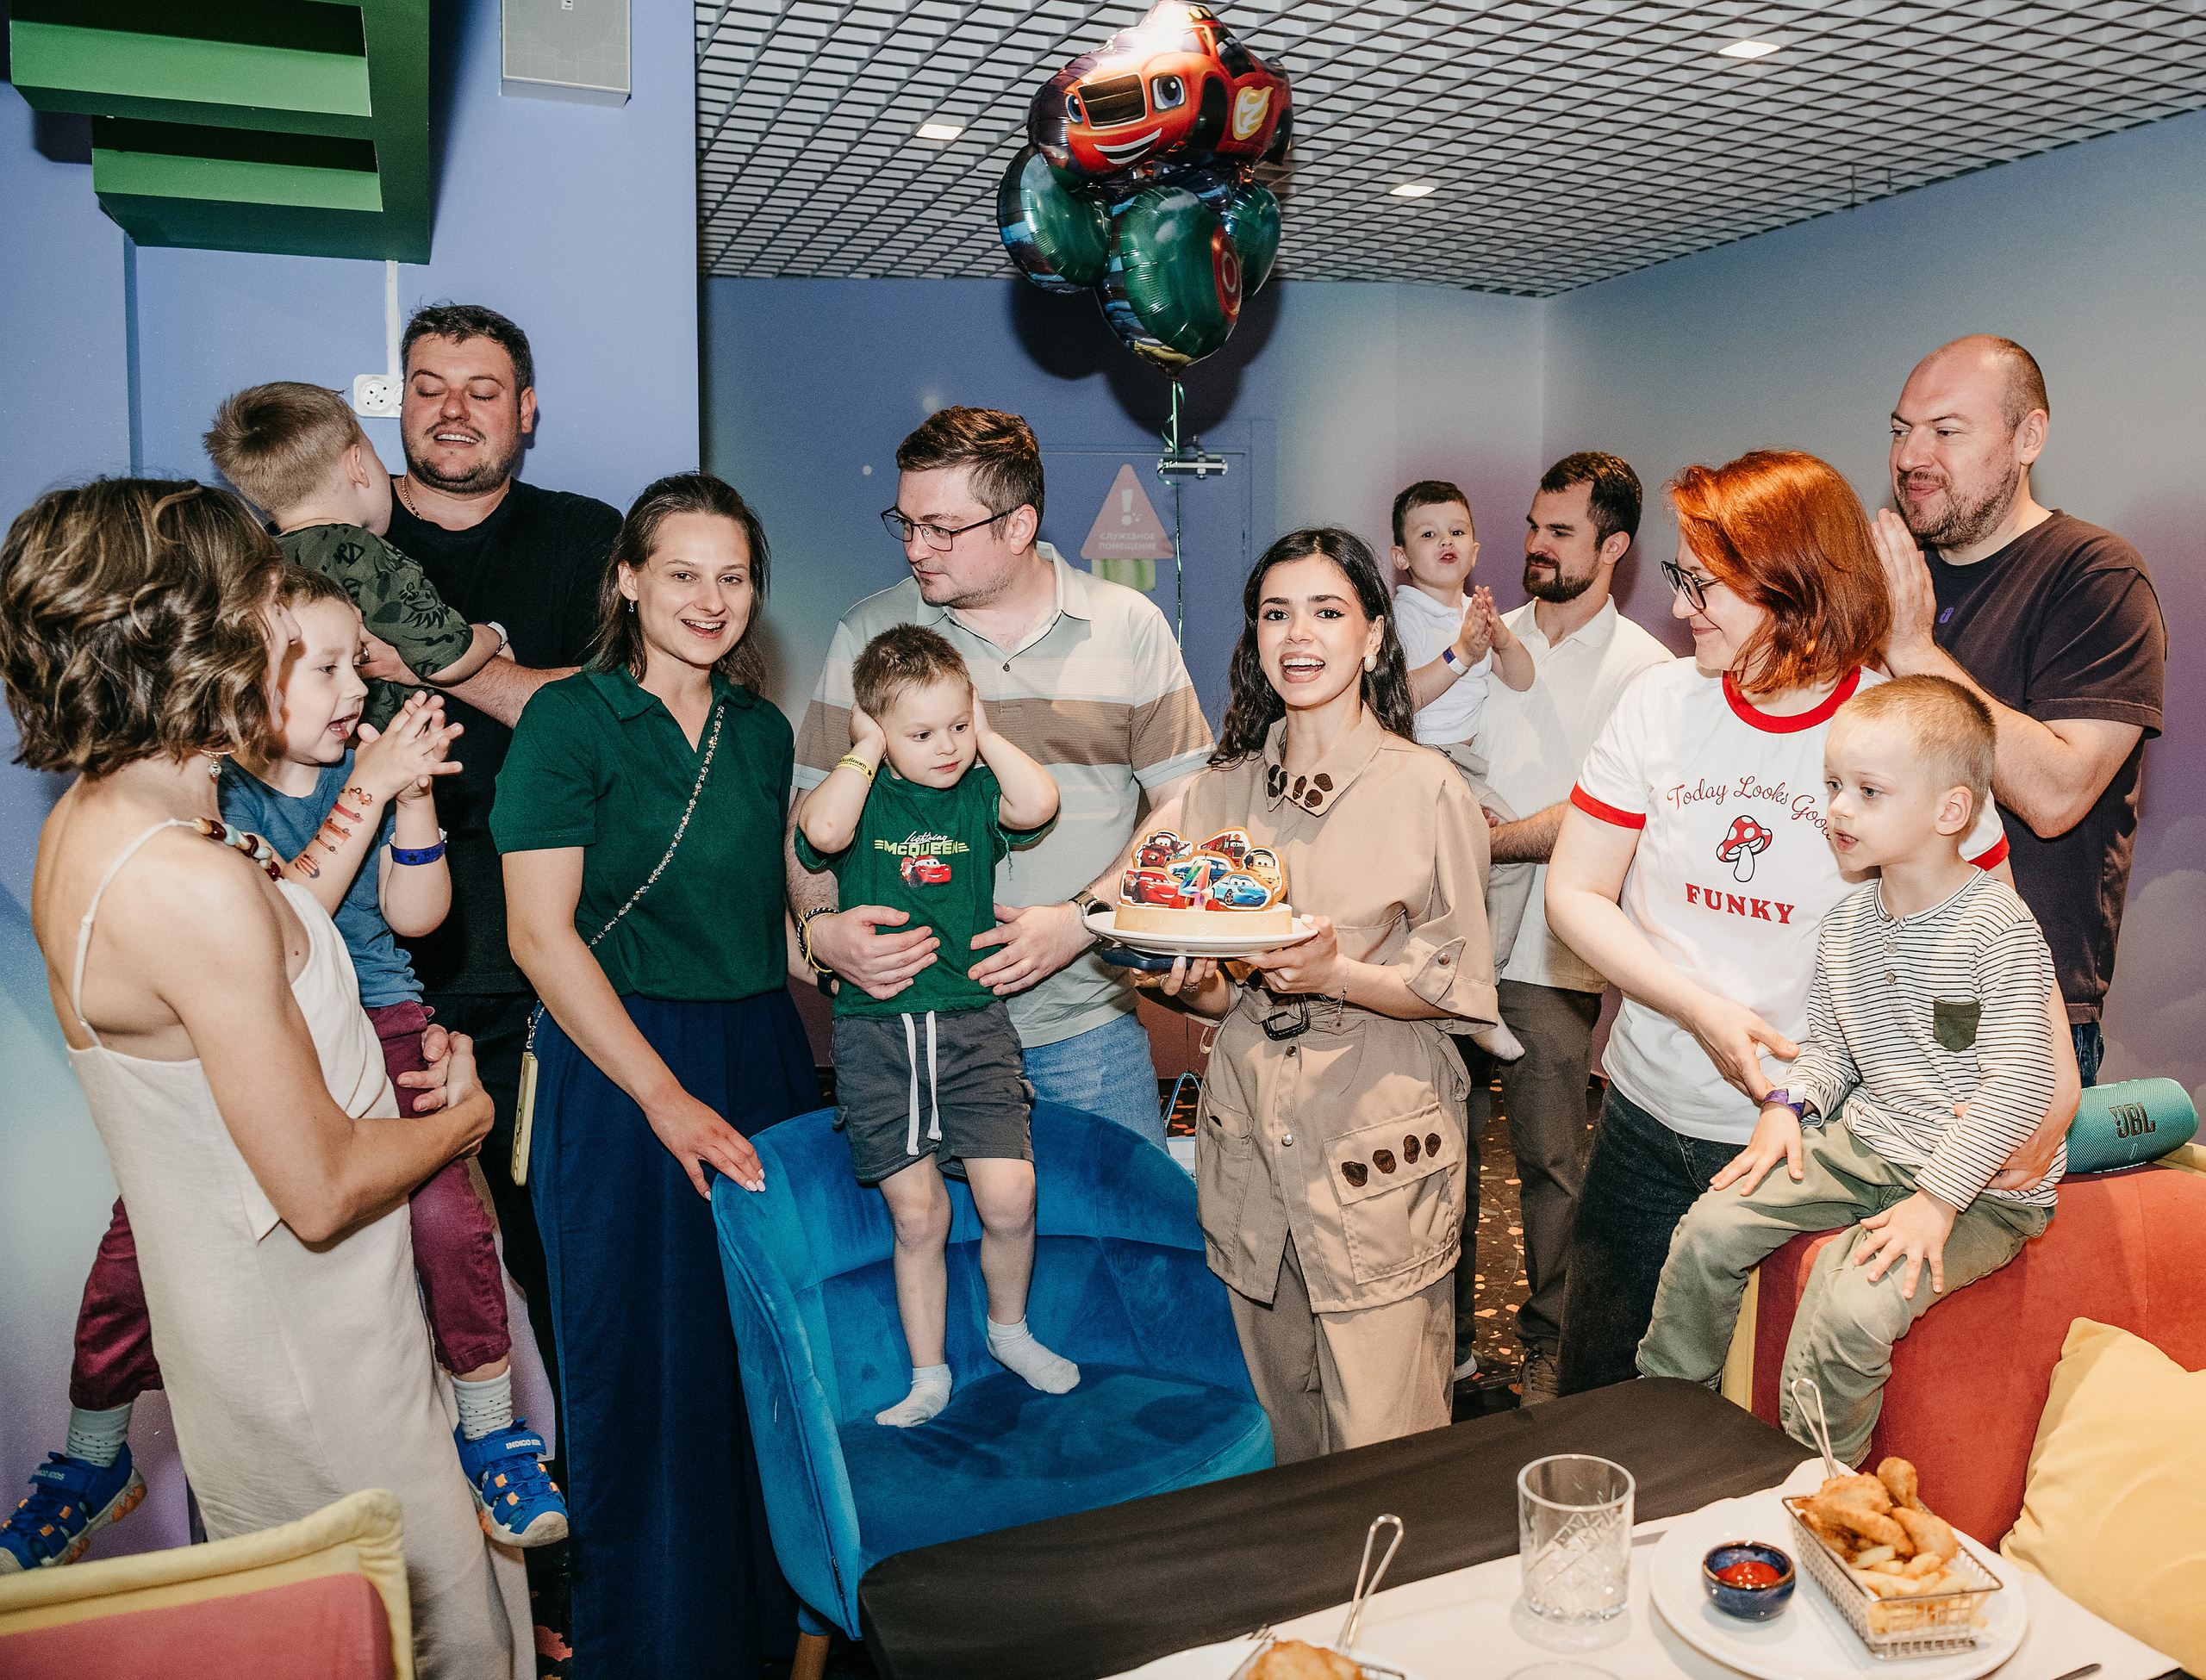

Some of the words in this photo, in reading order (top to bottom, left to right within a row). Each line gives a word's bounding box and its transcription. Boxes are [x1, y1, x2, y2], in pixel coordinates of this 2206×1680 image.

[1667, 778, 1729, 812] Today
[1733, 775, 1790, 805] Looks
[900, 831, 954, 847] Lightning
[1685, 882, 1795, 924] FUNKY
[2109, 1102, 2156, 1139] JBL
[505, 1439, 532, 1450] INDIGO
